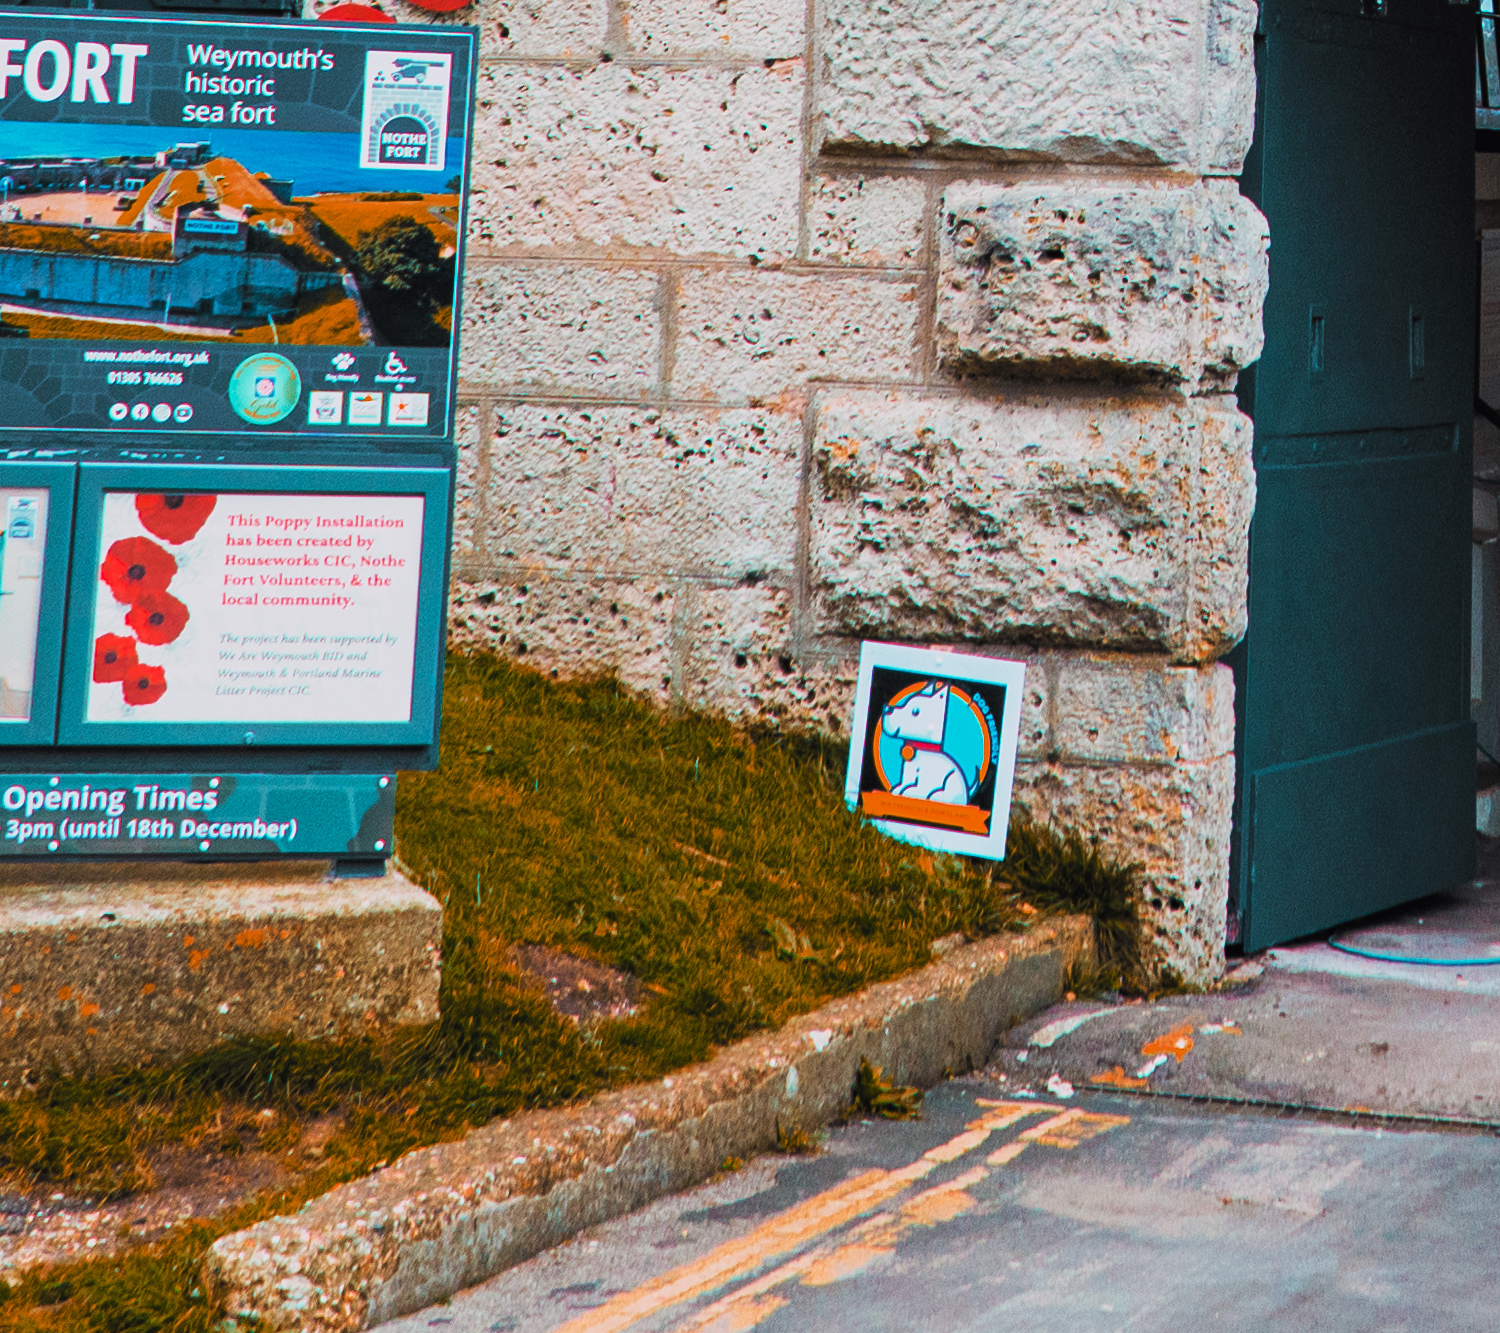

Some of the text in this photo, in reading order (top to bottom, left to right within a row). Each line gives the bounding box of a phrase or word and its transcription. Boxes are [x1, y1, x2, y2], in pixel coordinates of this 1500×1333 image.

[184, 70, 276, 97] historic
[182, 100, 276, 125] sea fort
[381, 132, 427, 159] NOTHE FORT
[84, 349, 210, 368] www.nothefort.org.uk
[228, 514, 404, 531] This Poppy Installation
[226, 534, 375, 551] has been created by
[224, 554, 405, 569] Houseworks CIC, Nothe
[223, 573, 392, 589] Fort Volunteers, & the
[221, 593, 355, 609] local community.
[220, 633, 398, 646] The project has been supported by
[219, 651, 367, 663] We Are Weymouth BID and
[218, 668, 382, 681] Weymouth & Portland Marine
[215, 686, 246, 696] Litter
[249, 686, 286, 697] Project
[973, 693, 990, 714] DOG
[3, 784, 126, 817] Opening
[133, 784, 218, 811] Times
[5, 819, 55, 844] 3pm
[60, 817, 122, 840] (until
[126, 818, 175, 839] 18th
[179, 817, 298, 842] December)
